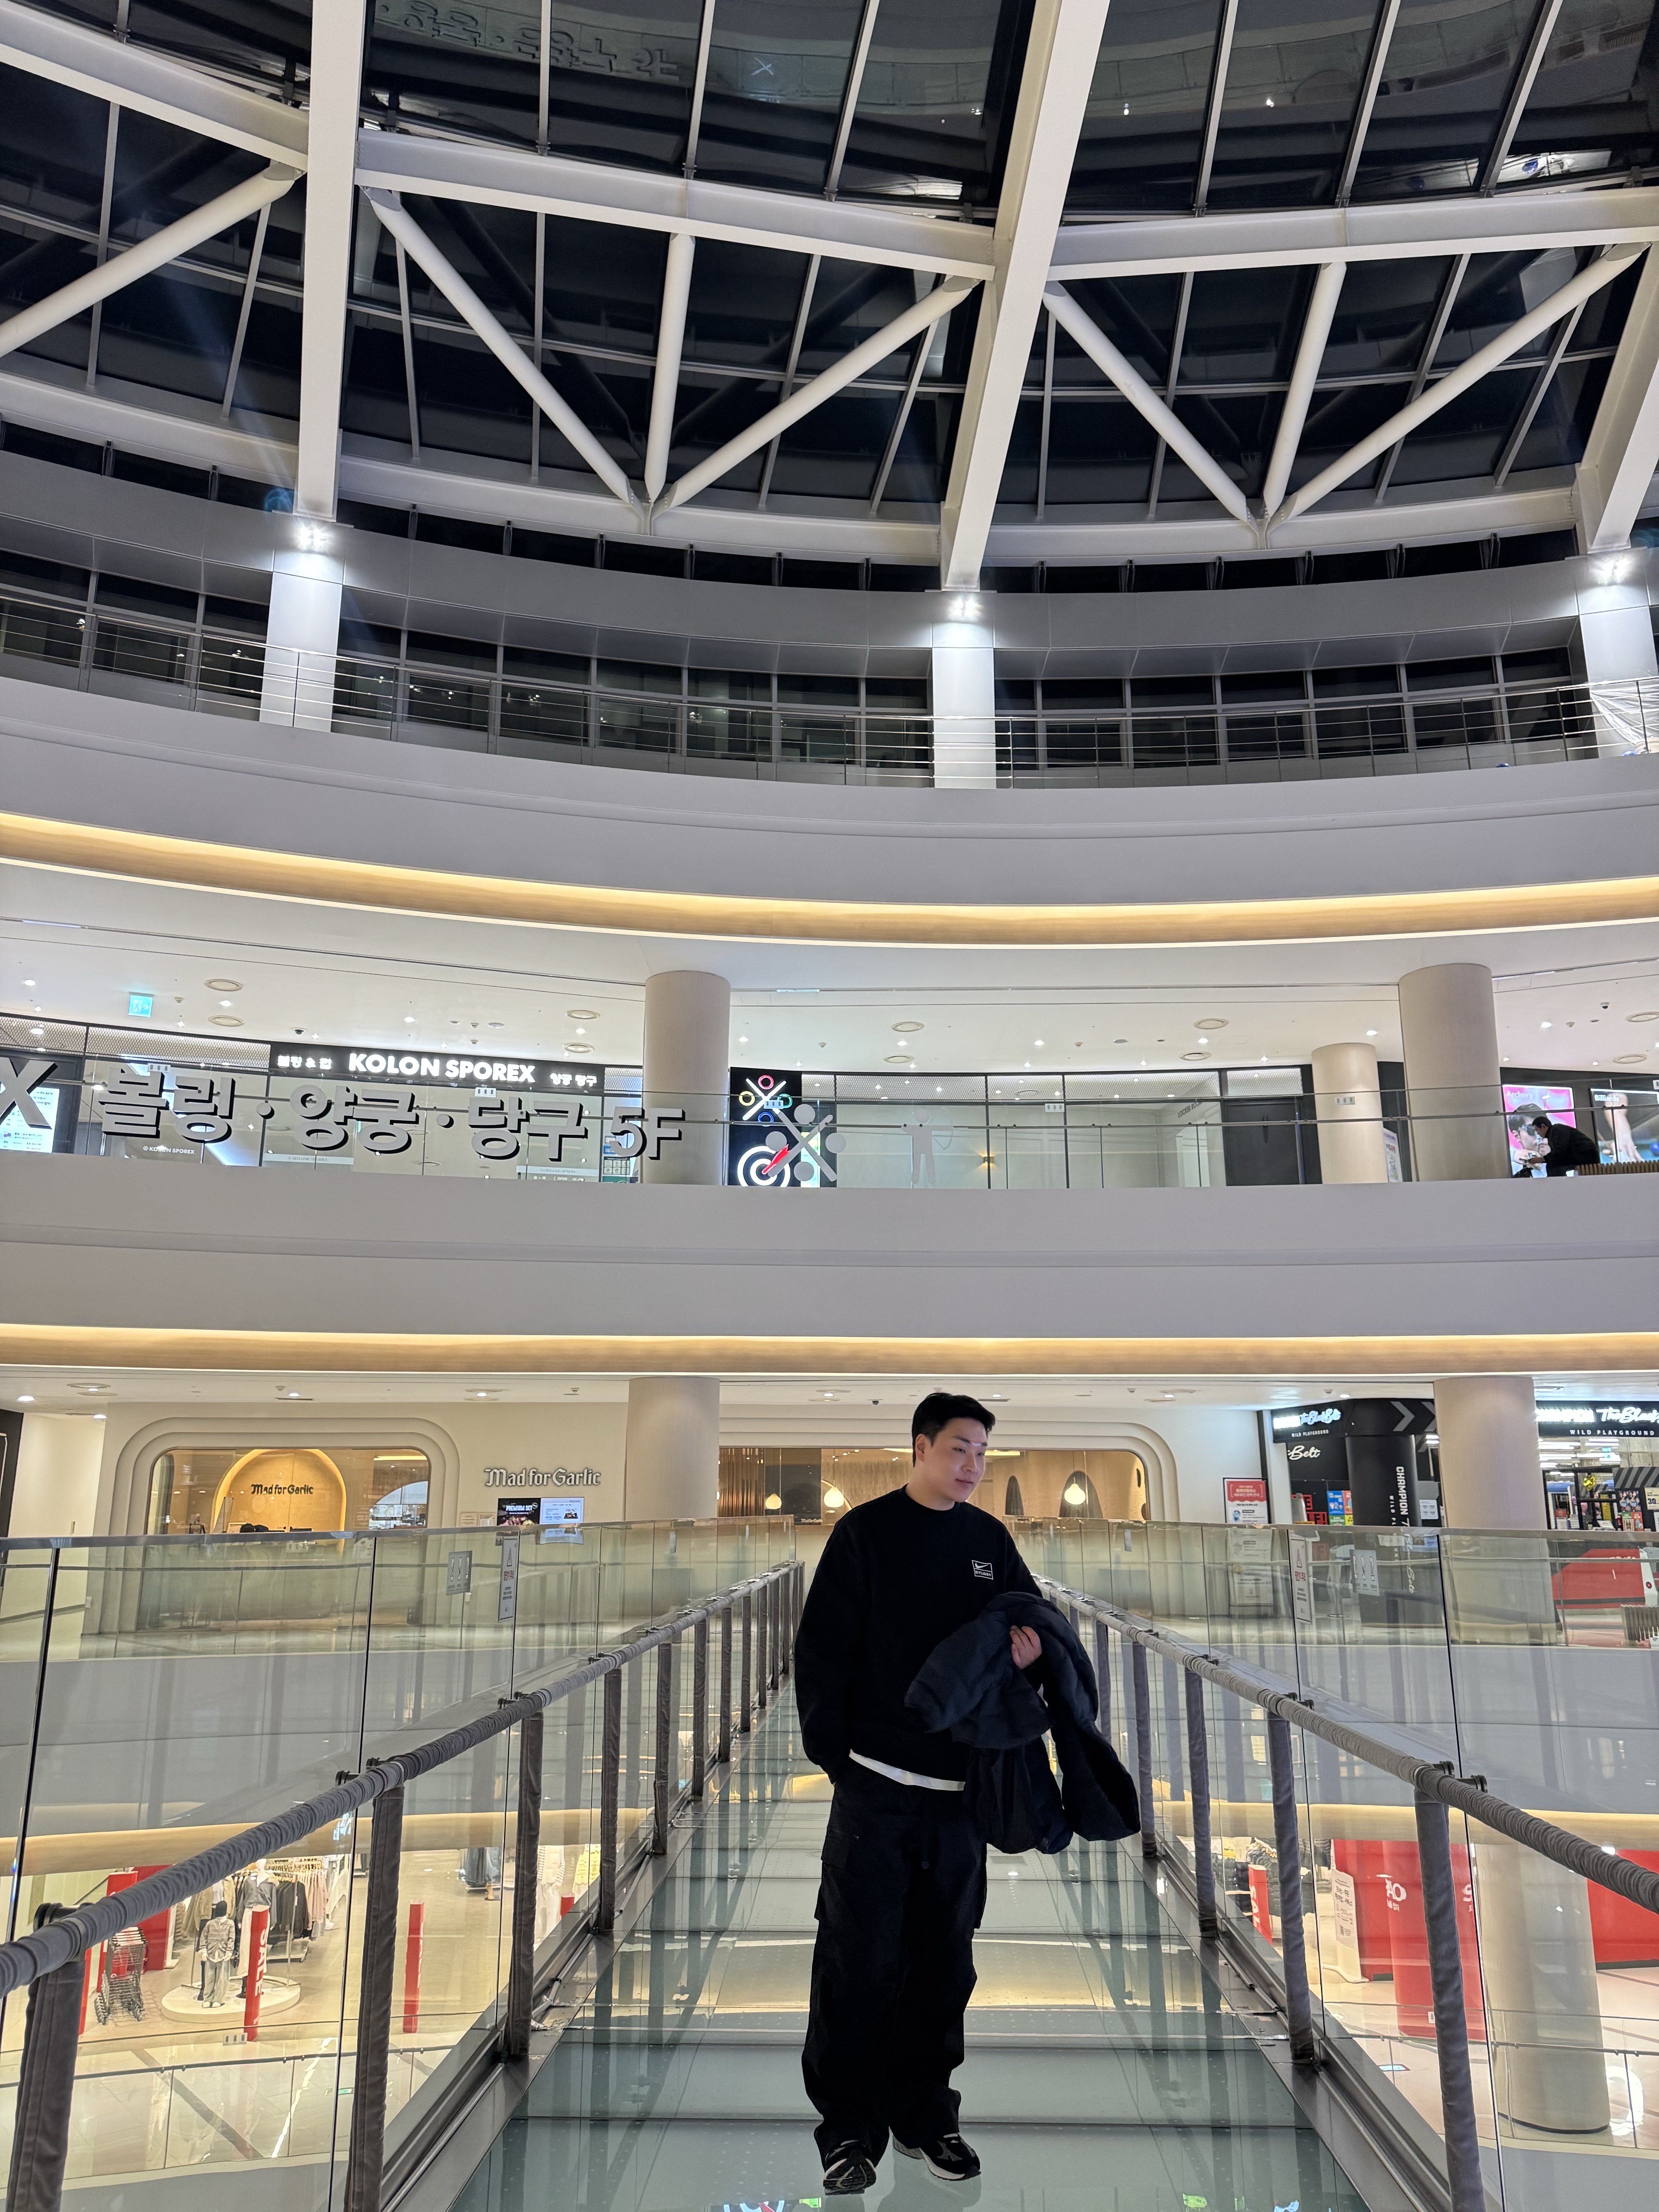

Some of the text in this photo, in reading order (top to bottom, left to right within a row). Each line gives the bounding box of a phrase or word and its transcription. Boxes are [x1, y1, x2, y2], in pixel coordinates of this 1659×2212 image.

[349, 1053, 536, 1083] KOLON SPOREX
[550, 1073, 597, 1087] 양궁 당구
[609, 1106, 686, 1160] 5F
[1289, 1445, 1321, 1460] Belt
[484, 1467, 601, 1487] Mad for Garlic
[251, 1484, 314, 1495] Mad for Garlic
[1396, 1466, 1409, 1515] CHAMPION
